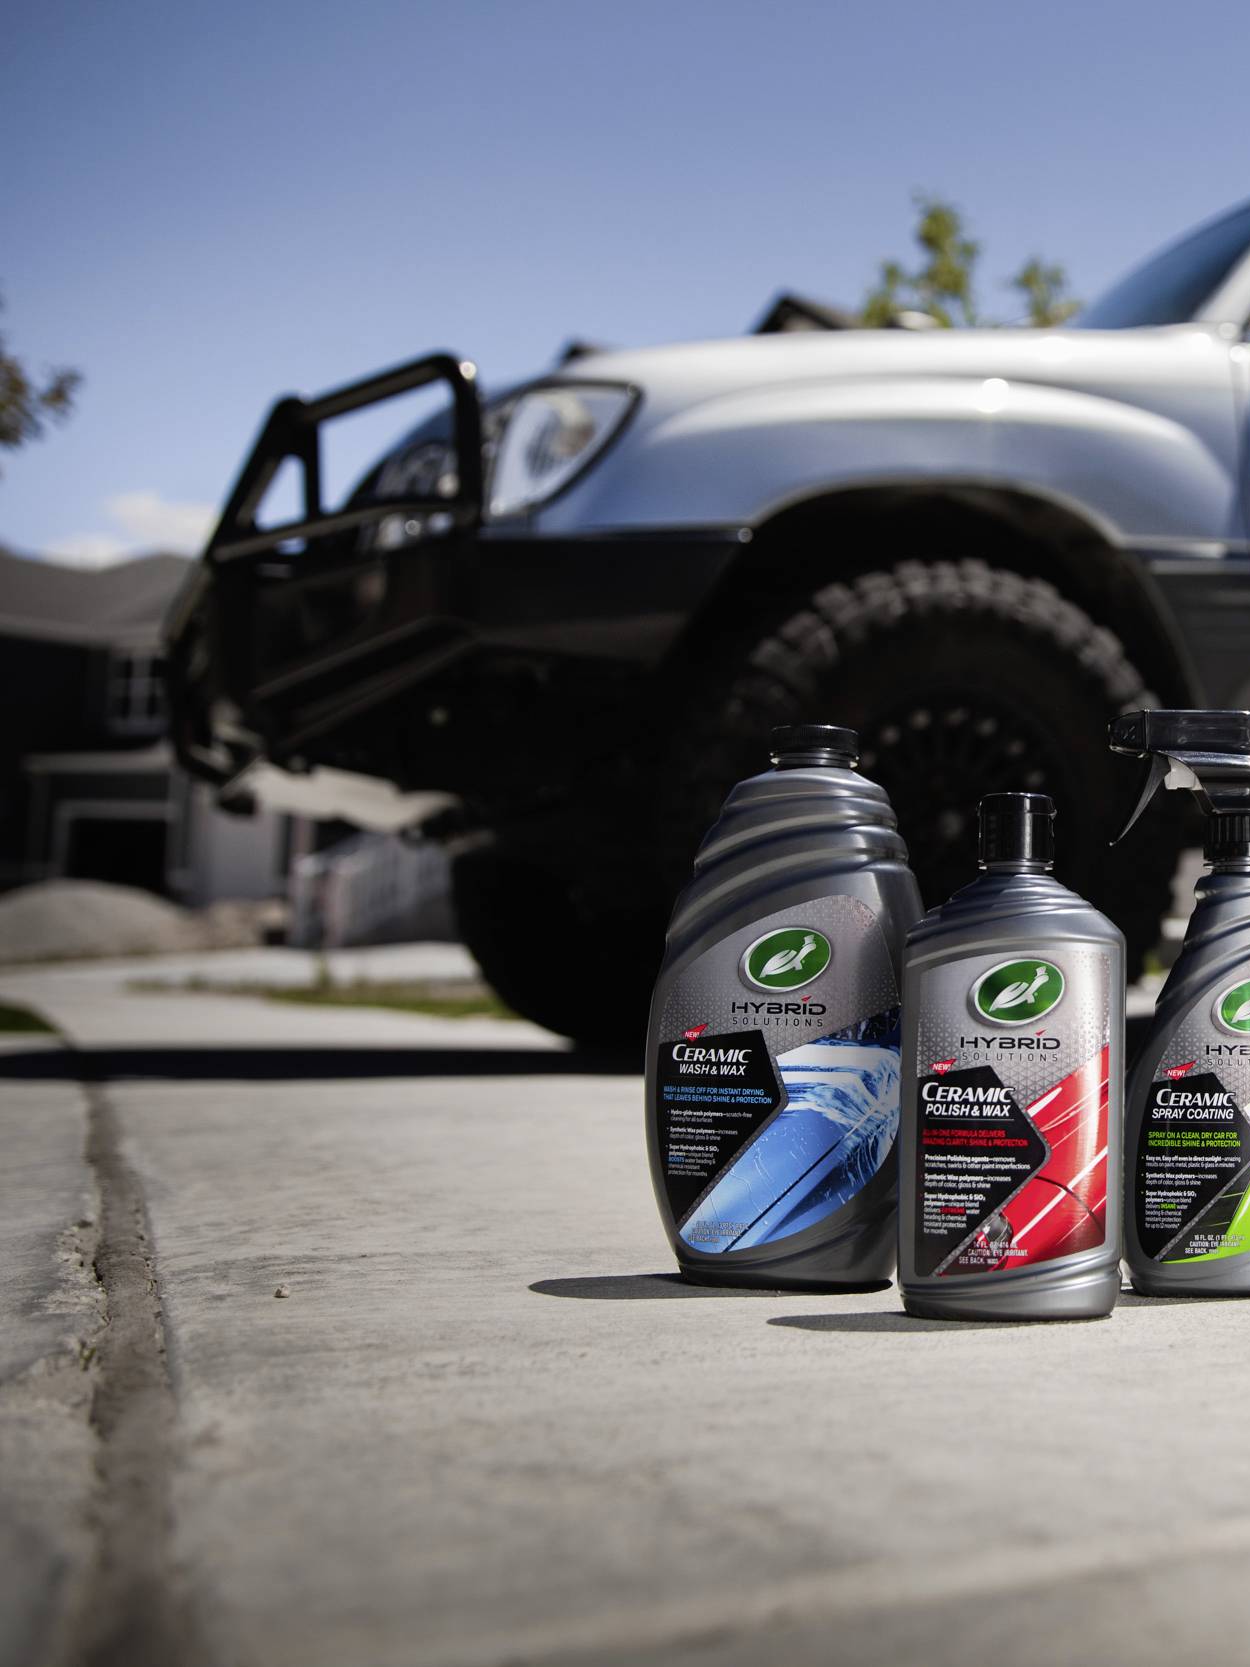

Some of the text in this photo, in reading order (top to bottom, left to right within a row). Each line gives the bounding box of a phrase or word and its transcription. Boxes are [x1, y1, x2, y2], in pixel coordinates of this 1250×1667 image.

[731, 1001, 827, 1015] HYBRID
[732, 1017, 824, 1027] SOLUTIONS
[684, 1031, 700, 1039] NEW!
[960, 1036, 1060, 1050] HYBRID
[672, 1043, 752, 1064] CERAMIC
[962, 1052, 1058, 1062] SOLUTIONS
[679, 1063, 746, 1076] WASH & WAX
[681, 1086, 696, 1094] RINSE
[707, 1087, 717, 1095] FOR
[742, 1088, 765, 1096] DRYING
[921, 1082, 1015, 1103] CERAMIC
[692, 1094, 711, 1102] BEHIND
[736, 1096, 773, 1104] PROTECTION
[1156, 1088, 1236, 1107] CERAMIC
[925, 1103, 1011, 1117] POLISH & WAX
[1152, 1108, 1234, 1119] SPRAY COATING
[1148, 1131, 1166, 1139] SPRAY
[1148, 1140, 1181, 1148] INCREDIBLE
